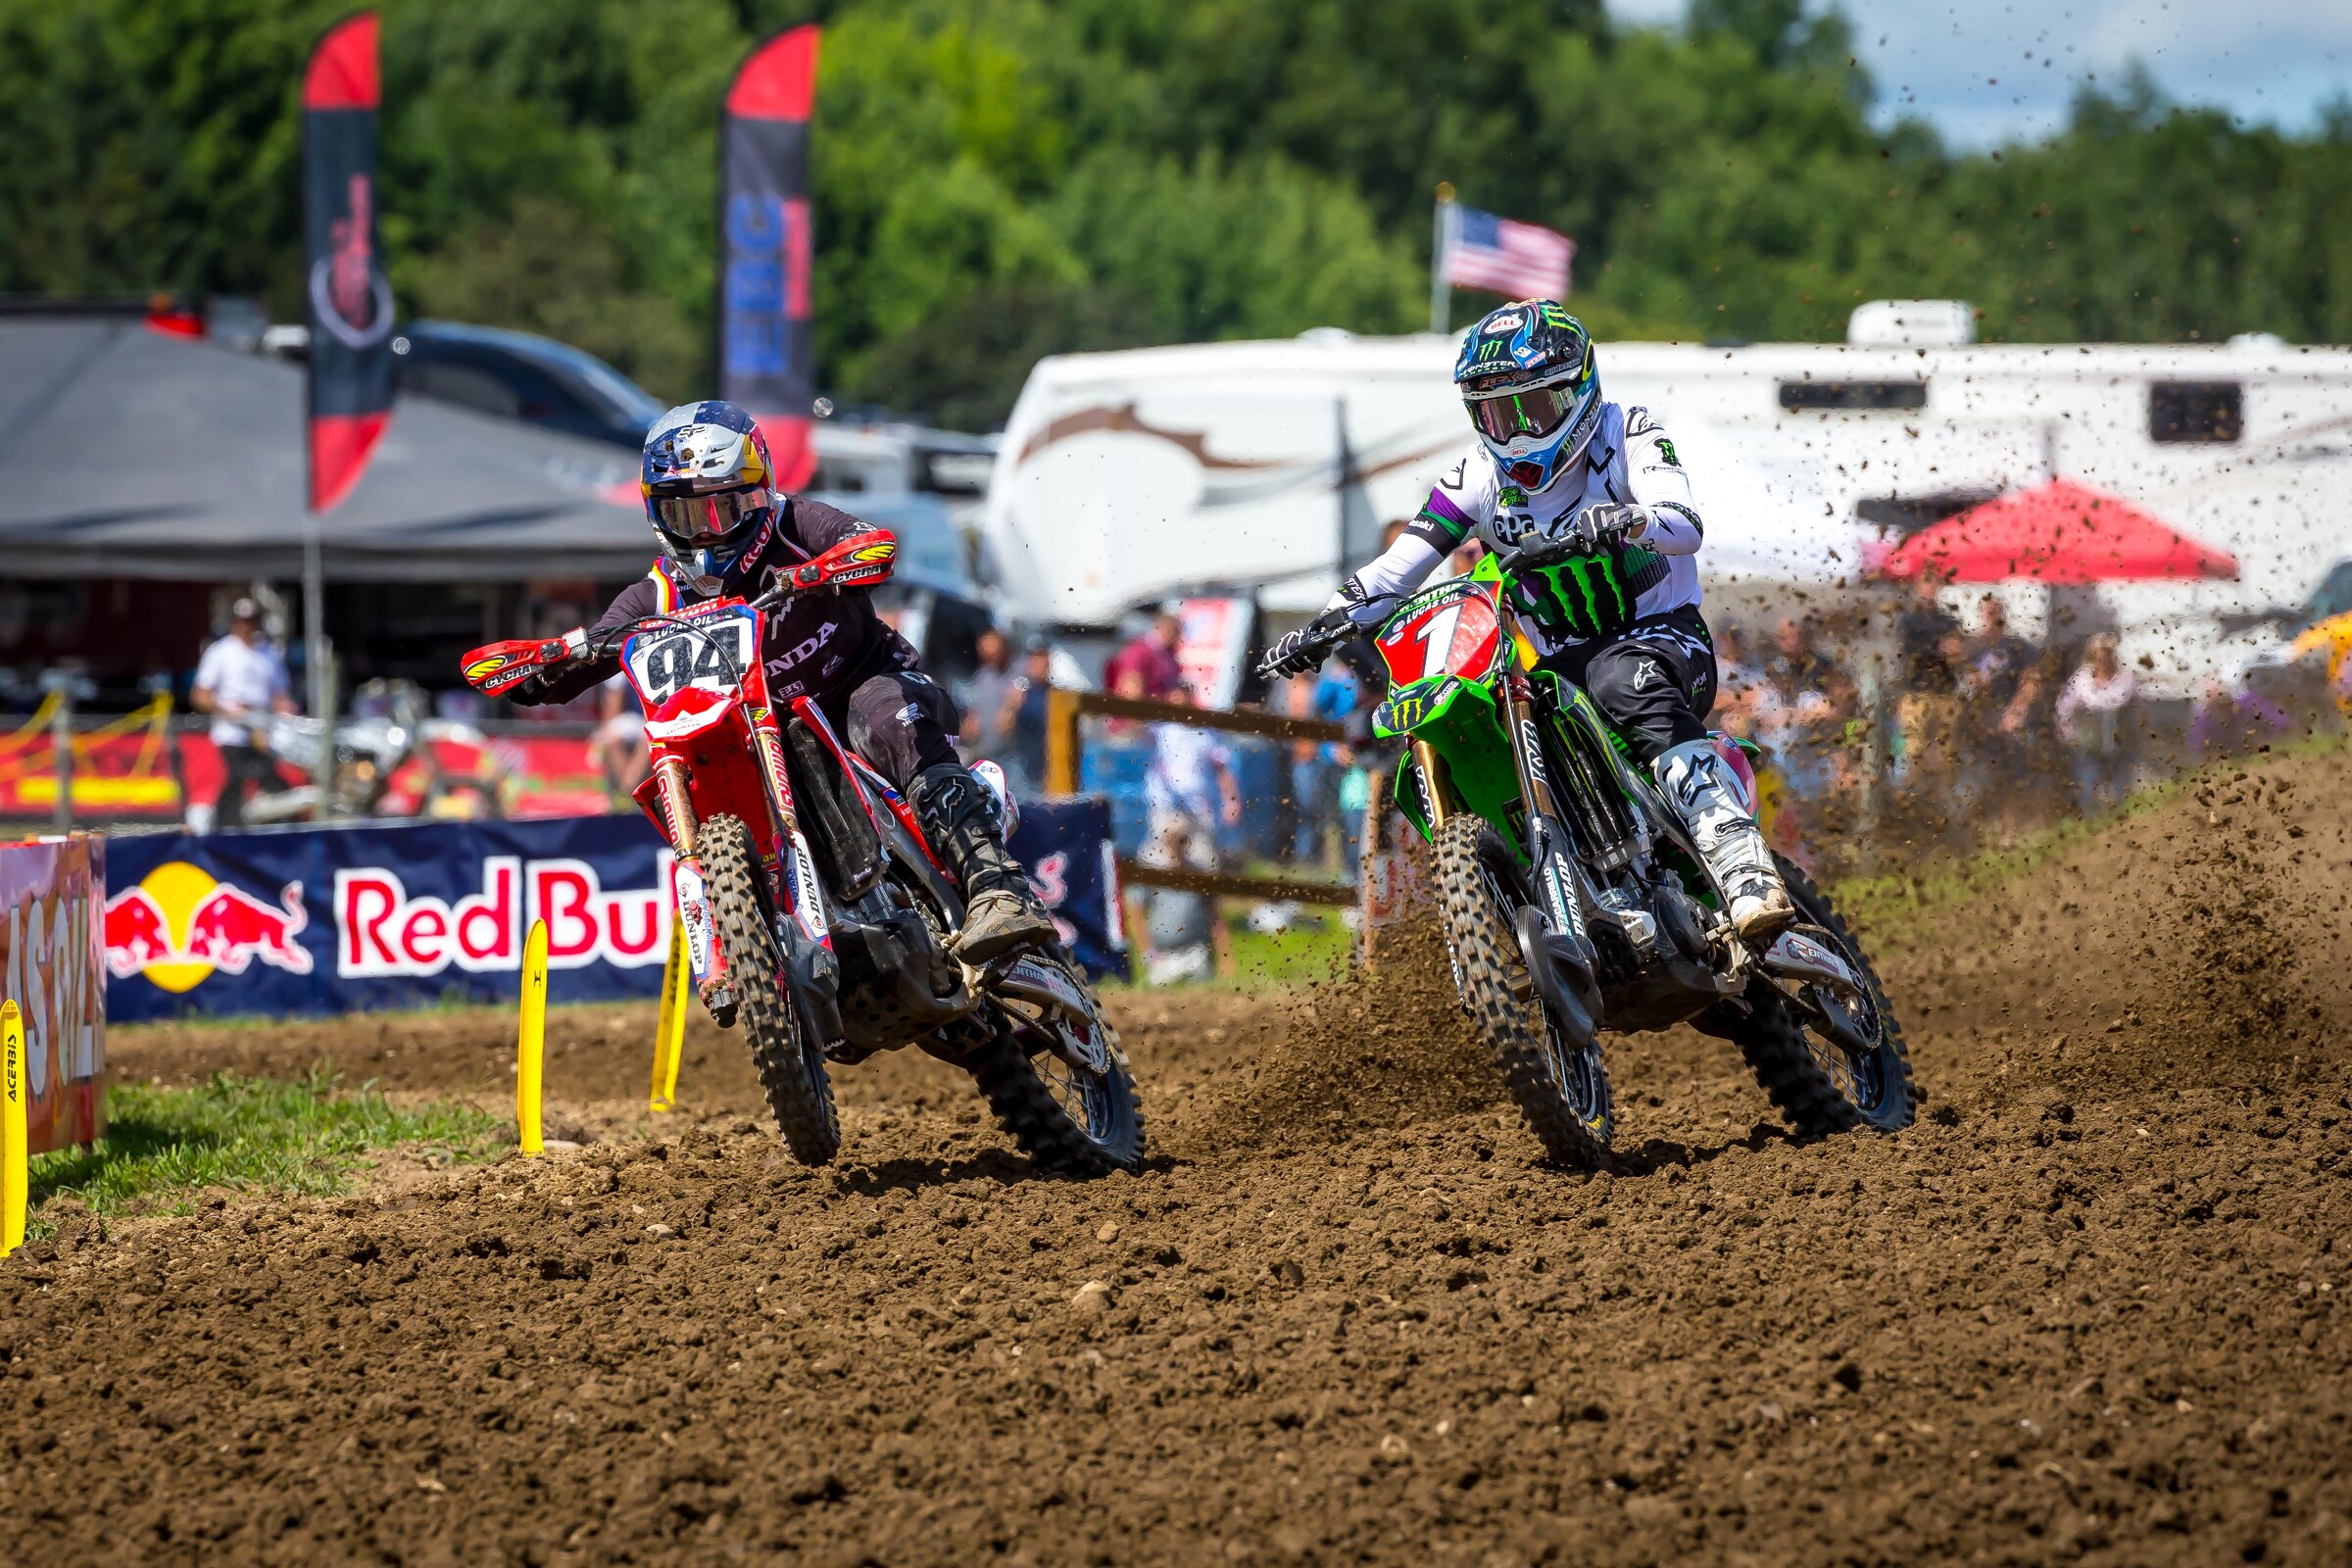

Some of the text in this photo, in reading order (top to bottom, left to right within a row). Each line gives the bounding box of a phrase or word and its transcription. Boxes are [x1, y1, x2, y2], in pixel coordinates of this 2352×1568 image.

[1490, 319, 1517, 330] BELL
[1458, 360, 1516, 378] MONSTER
[1494, 515, 1534, 543] PPG
[833, 564, 882, 583] CYCRA
[693, 614, 713, 627] OIL
[1406, 592, 1461, 625] LUCAS OIL
[764, 621, 839, 678] NDA
[1414, 602, 1465, 678] 1
[647, 625, 747, 707] 94
[797, 845, 821, 913] DUNLOP
[1544, 867, 1562, 915] CARRILLO
[1554, 852, 1586, 936] DUNLOP
[342, 860, 680, 968] Red Bu
[683, 901, 703, 964] DUNLOP
[1011, 964, 1047, 982] ENTHAL
